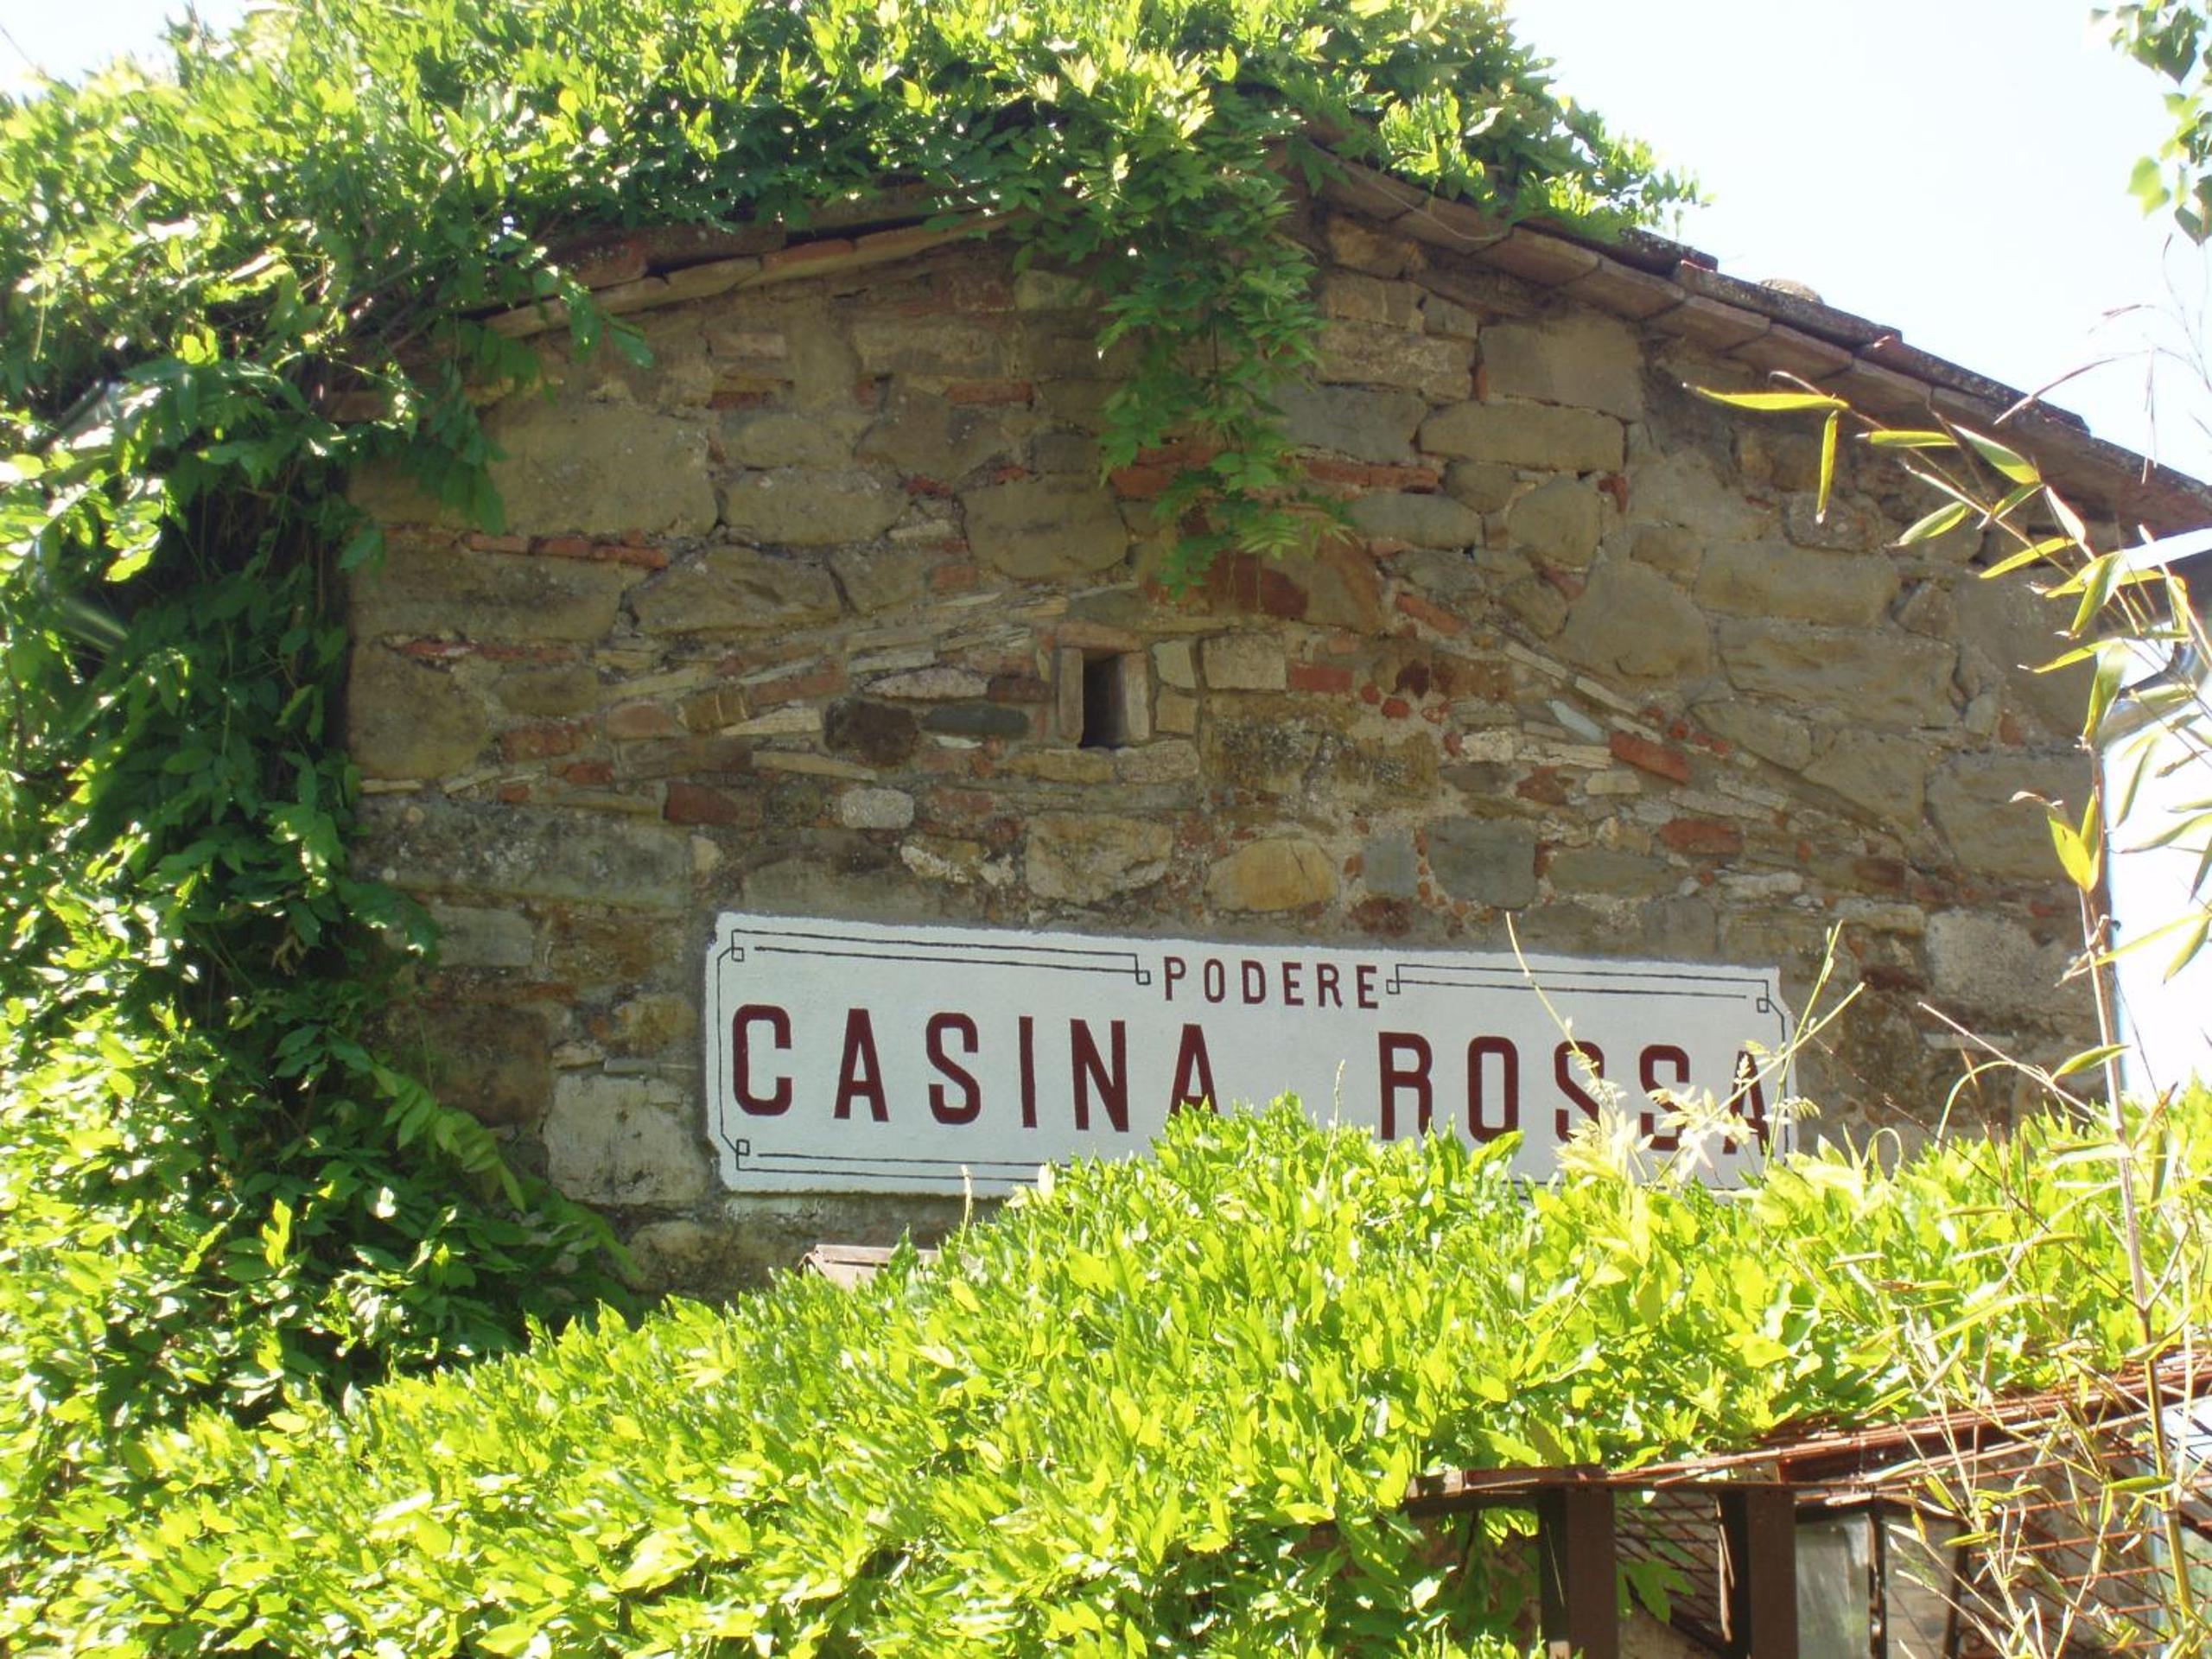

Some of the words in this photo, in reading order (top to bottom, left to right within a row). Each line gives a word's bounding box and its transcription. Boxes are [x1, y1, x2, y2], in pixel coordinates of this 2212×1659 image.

[1164, 956, 1379, 1009] PODERE
[732, 1003, 1219, 1134] CASINA
[1378, 1032, 1770, 1155] ROSSA
